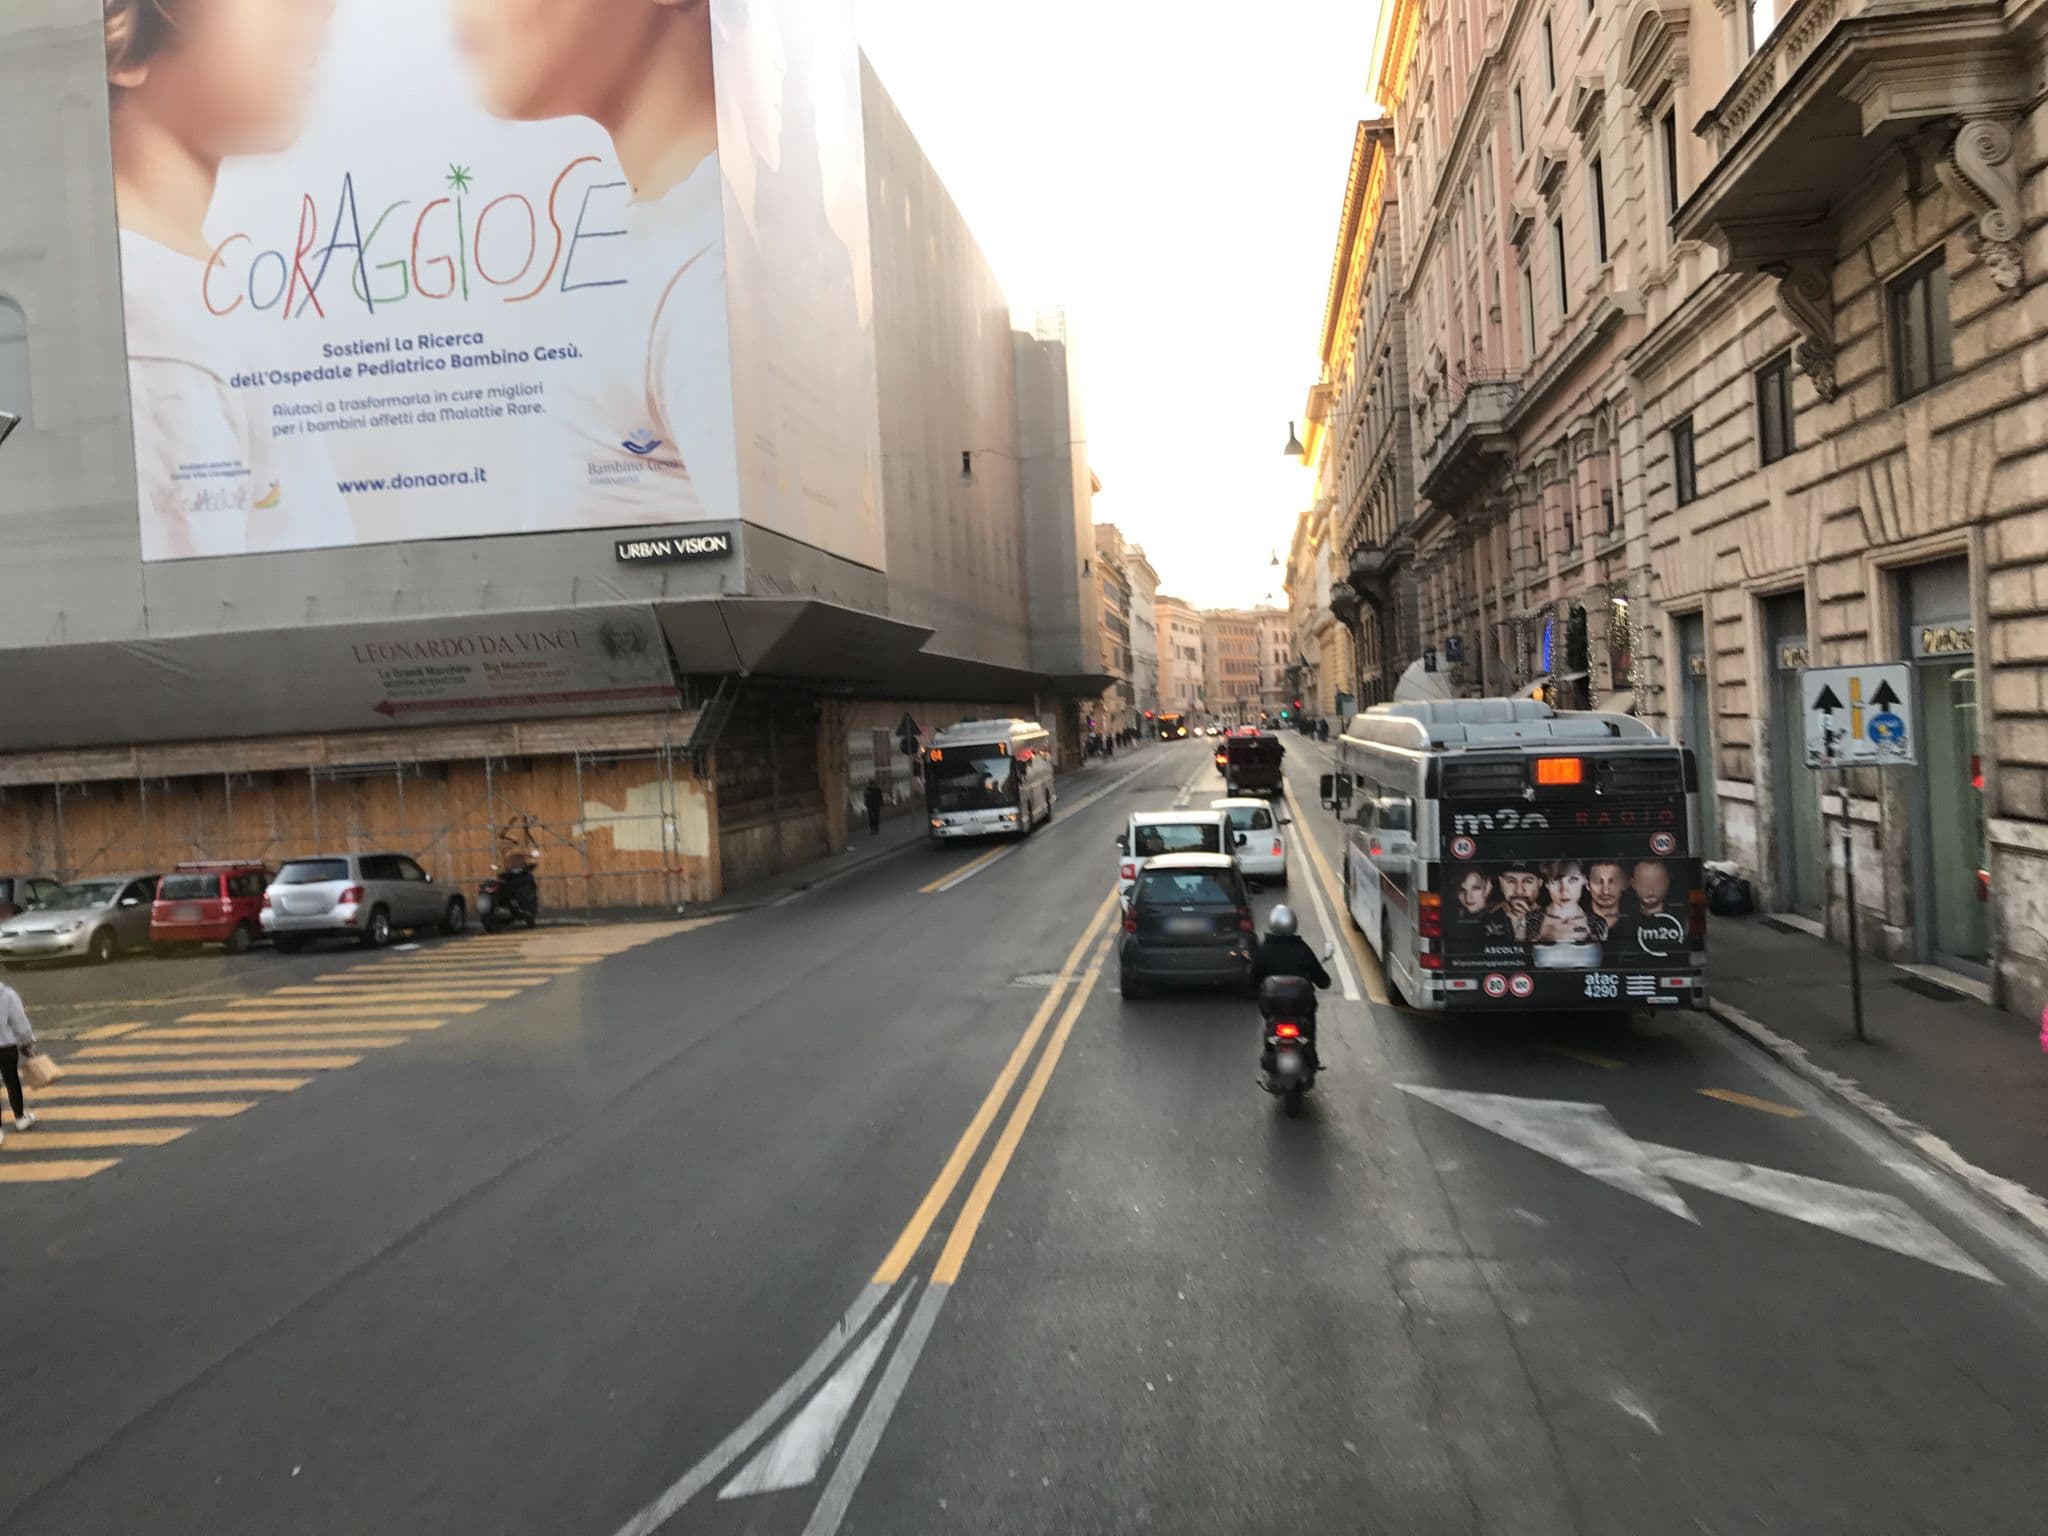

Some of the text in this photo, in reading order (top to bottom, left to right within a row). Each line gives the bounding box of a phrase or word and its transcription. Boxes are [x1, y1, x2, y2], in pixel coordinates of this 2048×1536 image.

[322, 331, 484, 359] Sostieni la Ricerca
[230, 342, 583, 389] dell'Ospedale Pediatrico Bambino Gesù.
[272, 381, 544, 417] Aiutaci a trasformarla in cure migliori
[272, 423, 295, 439] per
[306, 415, 367, 434] bambini
[370, 412, 413, 430] affetti
[416, 410, 436, 425] da
[440, 404, 503, 422] Malattie
[507, 401, 546, 416] Rare.
[336, 466, 488, 494] www.donaora.it
[618, 535, 727, 560] URBAN VISION
[352, 629, 582, 664] LEONARDO DA VINCI
[1584, 984, 1618, 998] 4290
[1585, 972, 1620, 985] atac
